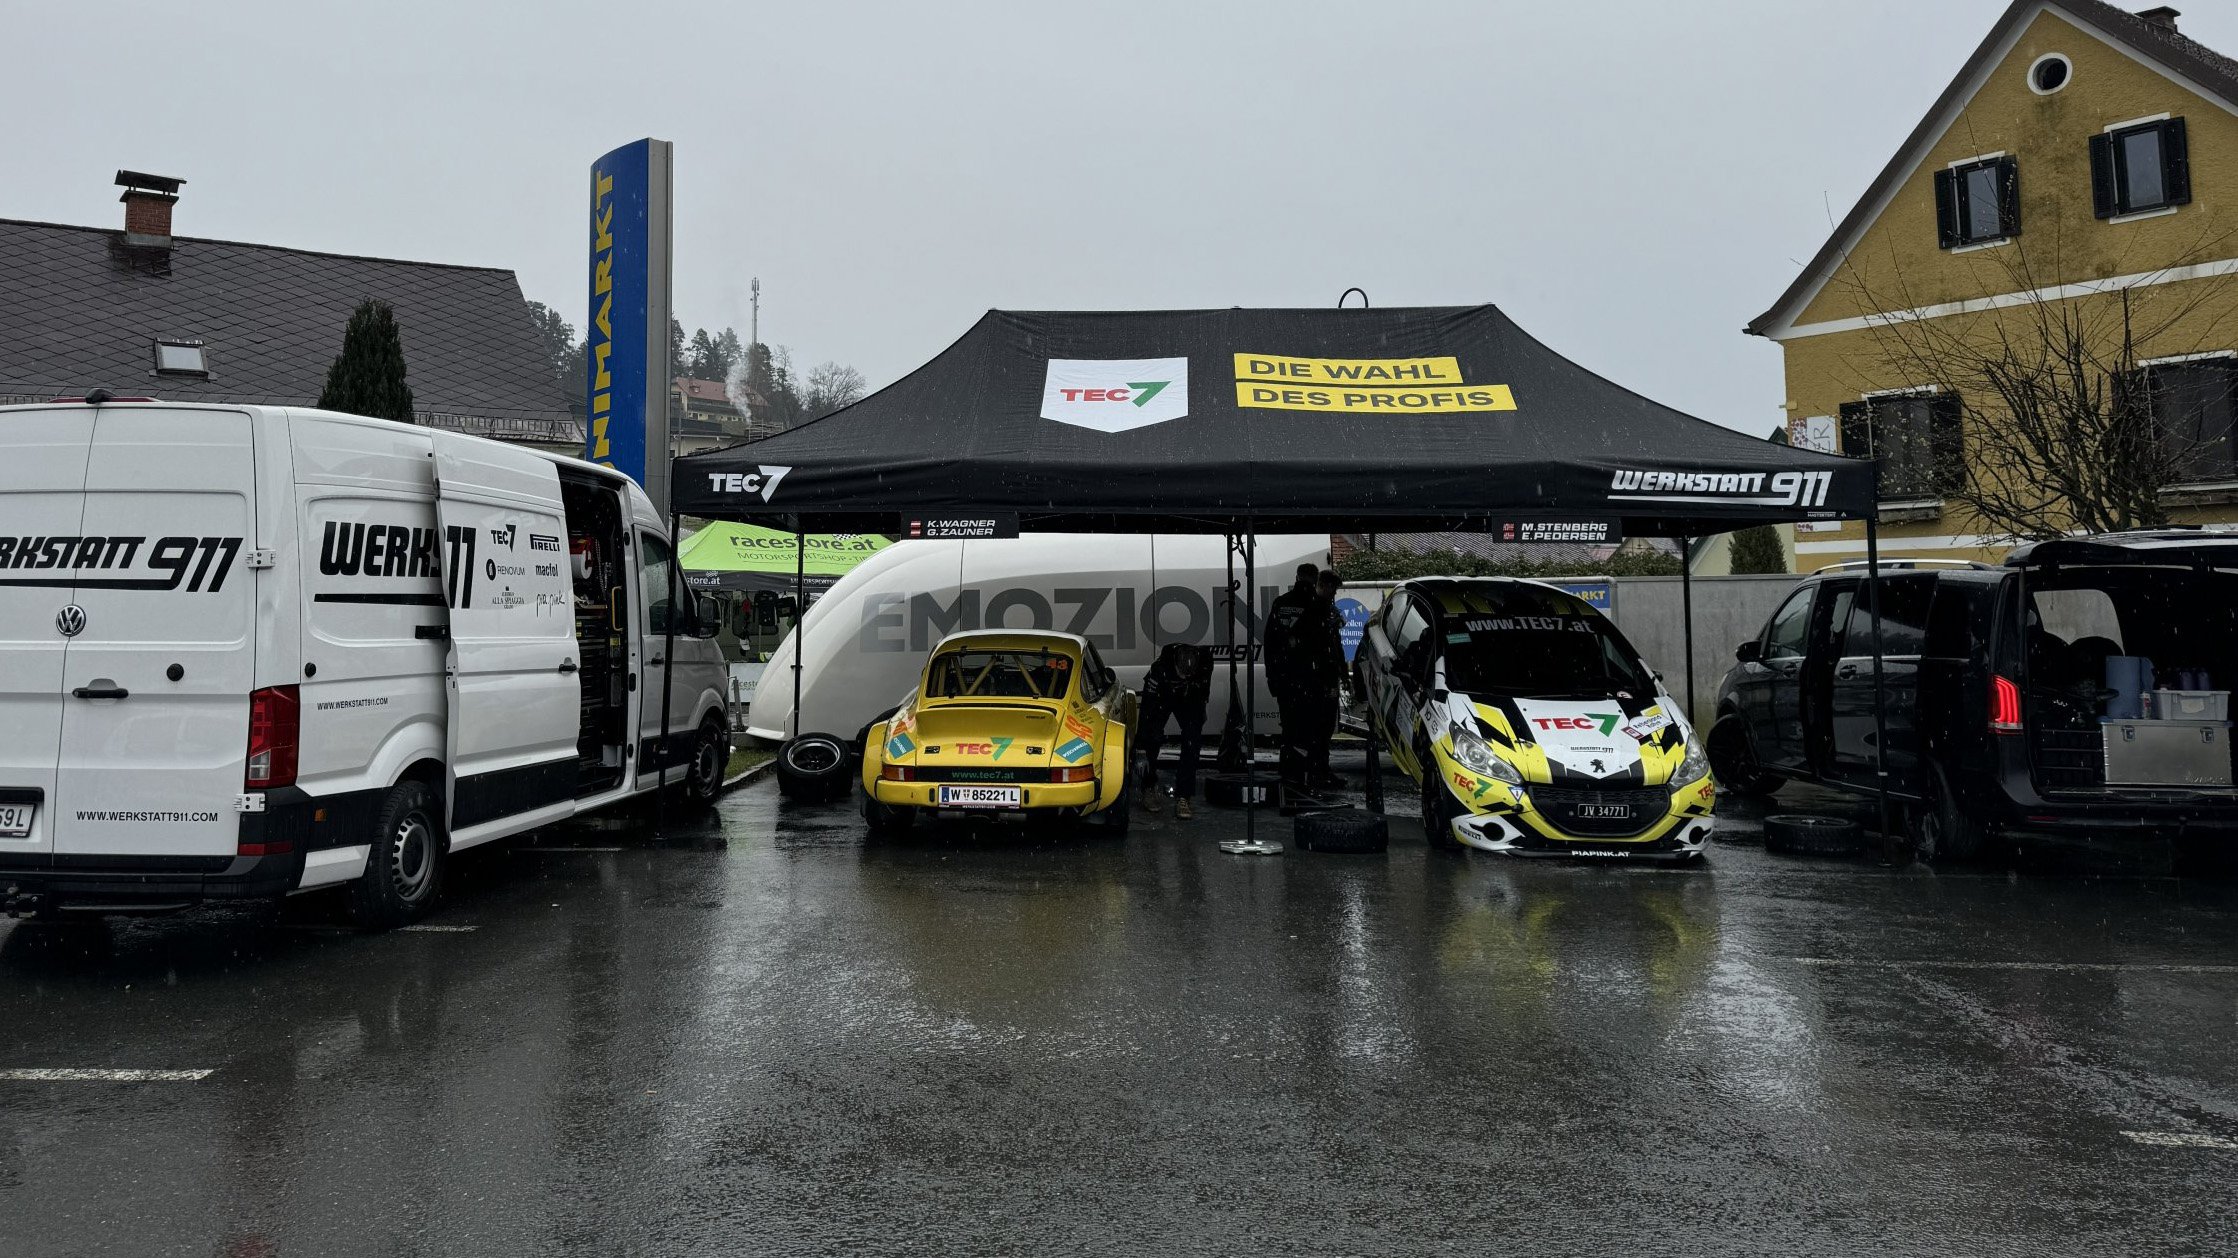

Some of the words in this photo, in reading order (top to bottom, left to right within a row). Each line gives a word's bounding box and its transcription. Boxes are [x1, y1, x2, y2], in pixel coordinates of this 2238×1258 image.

[593, 169, 614, 471] NIMARKT
[1249, 360, 1312, 378] DIE
[1322, 363, 1446, 379] WAHL
[1060, 381, 1171, 408] TEC7
[1252, 388, 1331, 407] DES
[1344, 390, 1494, 408] PROFIS
[708, 465, 793, 503] TEC7
[1611, 470, 1766, 493] WERKSTATT
[1771, 471, 1833, 507] 911
[927, 519, 996, 528] K.WAGNER
[927, 528, 993, 536] G.ZAUNER
[1521, 523, 1608, 532] M.STENBERG
[490, 524, 517, 553] TEC7
[529, 533, 560, 552] PIRELLI
[729, 534, 878, 551] racesore.at
[1521, 532, 1606, 541] E.PEDERSEN
[147, 536, 244, 593] 911
[1571, 591, 1606, 600] ARKT
[860, 585, 1297, 652] EMOZION
[1465, 616, 1595, 633] www.TEC7.at
[1531, 713, 1620, 737] TEC7
[956, 737, 1014, 761] TEC7
[951, 770, 1015, 780] www.tec7.at
[1453, 772, 1493, 799] TEC7
[951, 789, 961, 801] W
[972, 789, 1006, 801] 85221
[1010, 790, 1018, 802] L
[76, 810, 218, 823] WWW.WERKSTATT911.COM
[1584, 806, 1595, 816] JV
[1598, 806, 1624, 817] 34771
